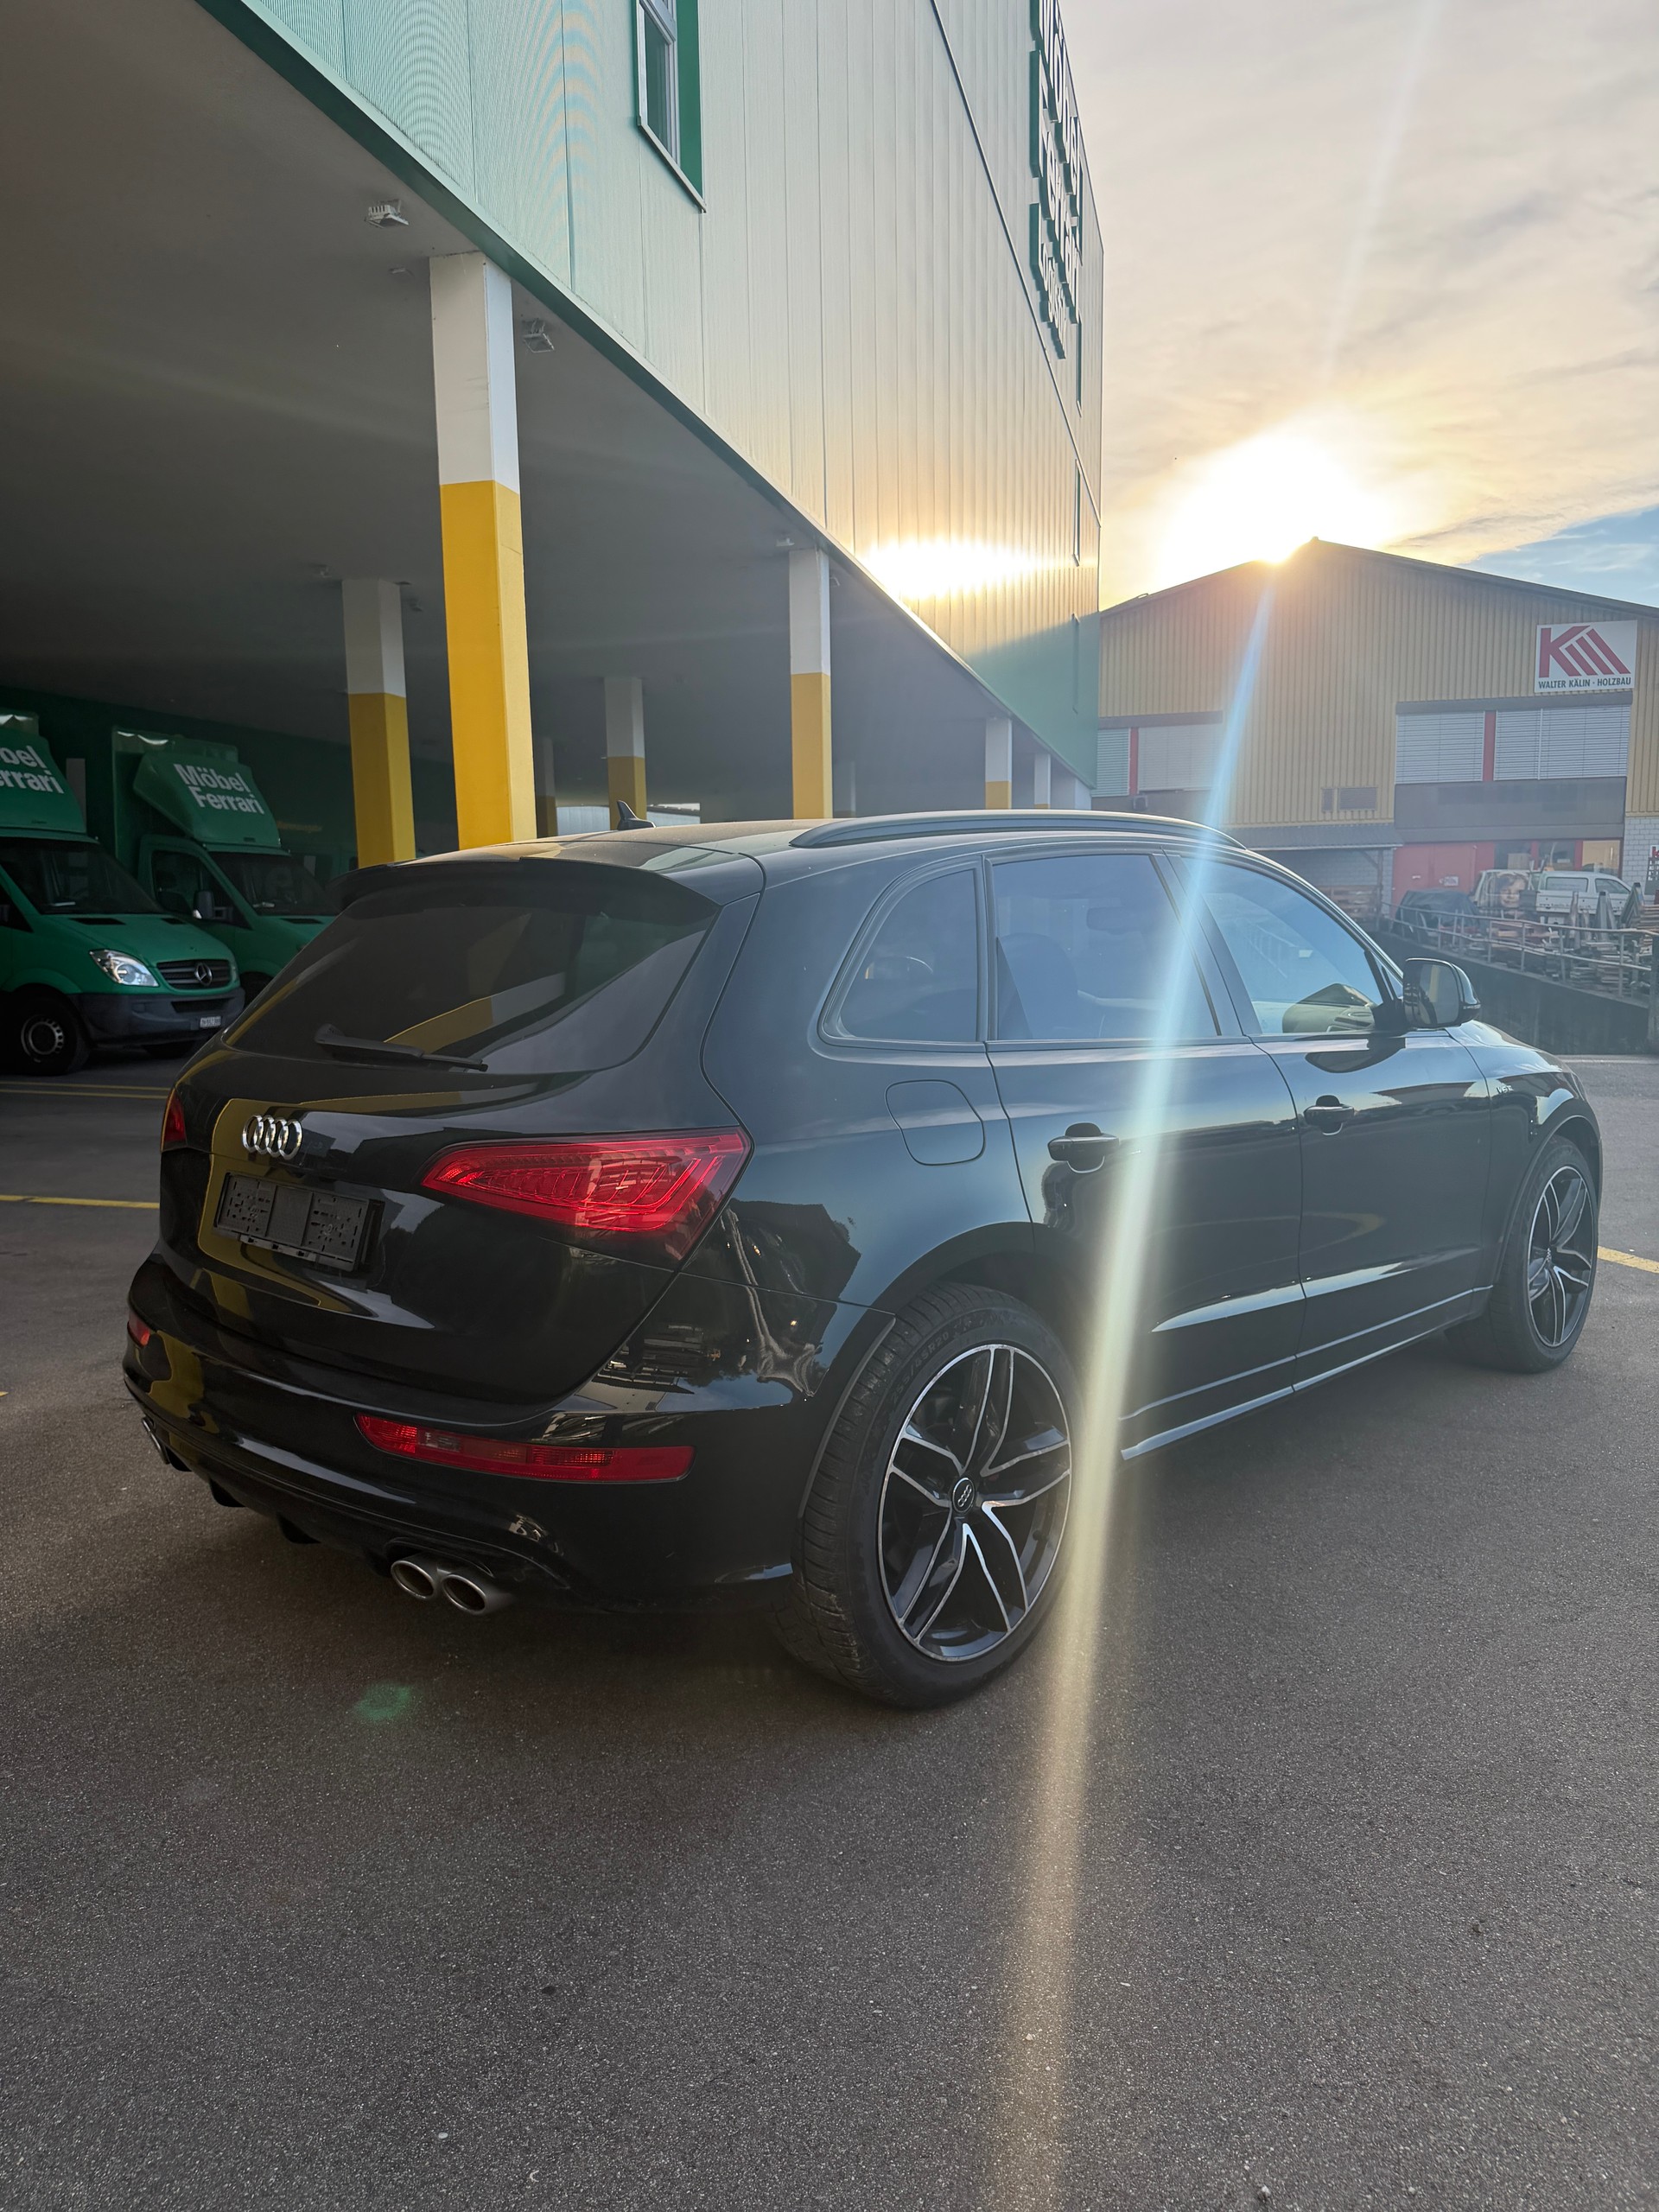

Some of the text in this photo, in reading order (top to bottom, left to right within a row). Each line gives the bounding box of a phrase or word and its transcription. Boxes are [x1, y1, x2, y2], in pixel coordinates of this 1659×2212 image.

[1039, 50, 1080, 322] Ferrari
[1039, 203, 1067, 358] Logistik
[1538, 677, 1631, 689] WALTER KÄLIN HOLZBAU
[0, 769, 65, 794] rrari
[173, 763, 251, 792] Möbel
[188, 785, 264, 815] Ferrari
